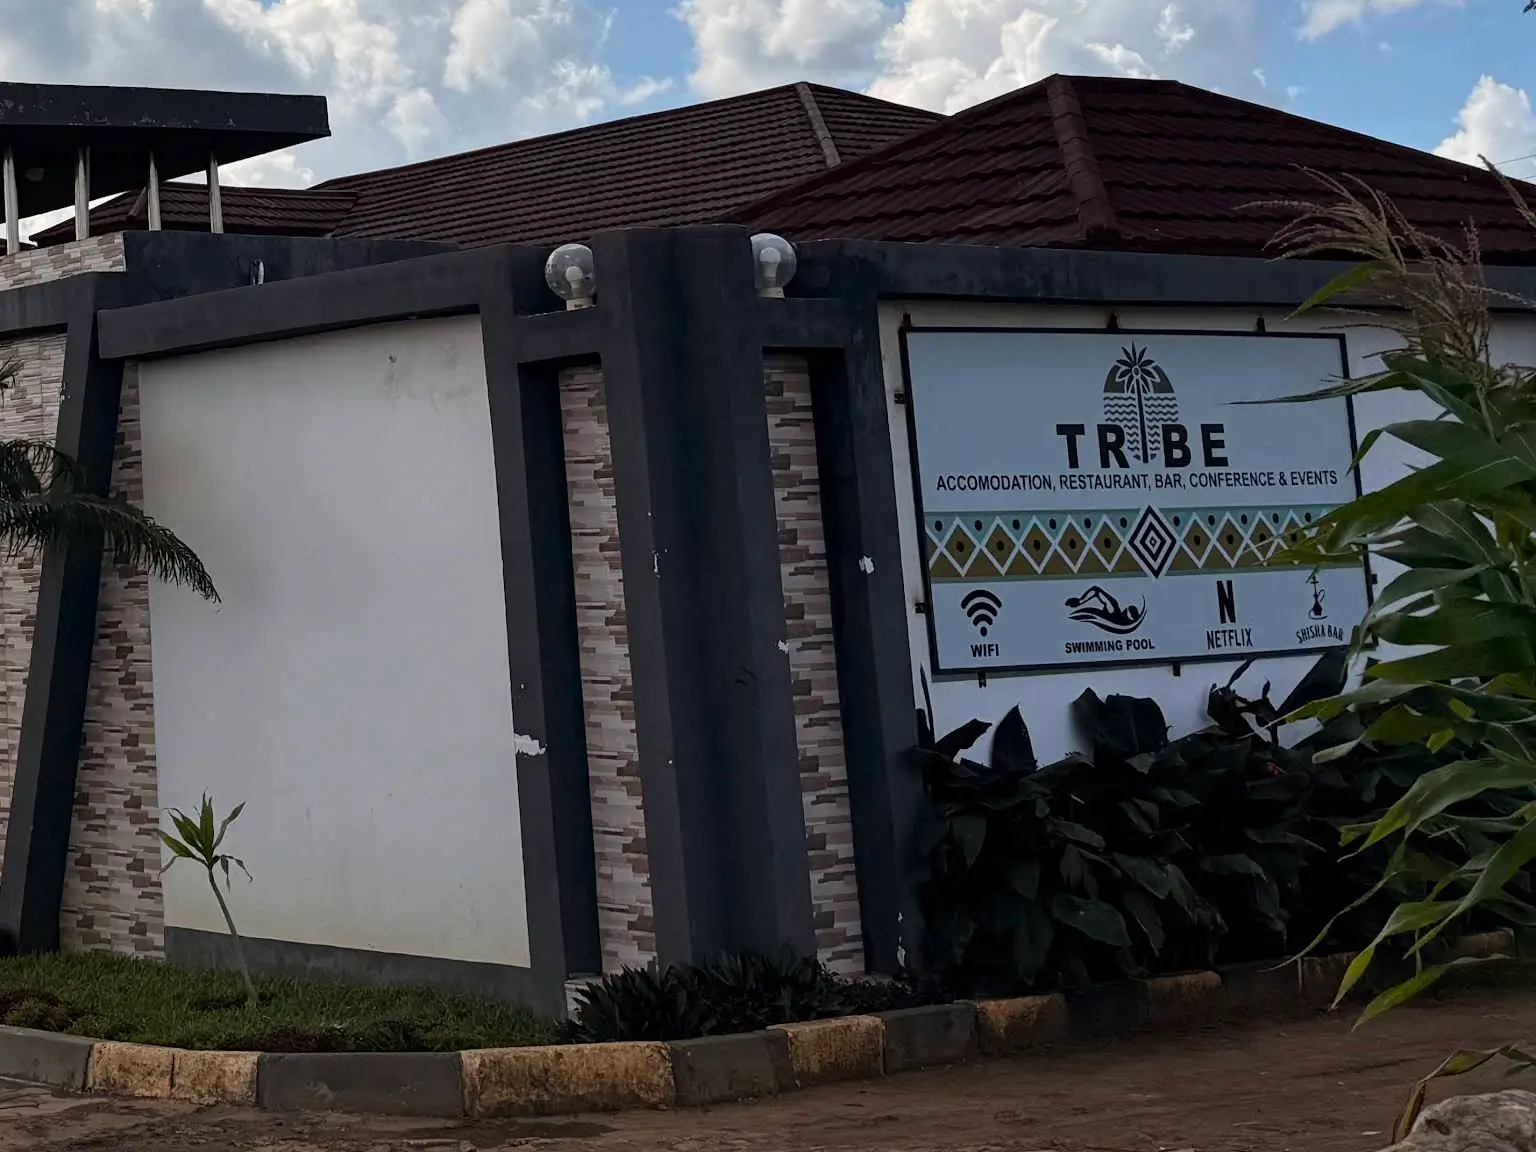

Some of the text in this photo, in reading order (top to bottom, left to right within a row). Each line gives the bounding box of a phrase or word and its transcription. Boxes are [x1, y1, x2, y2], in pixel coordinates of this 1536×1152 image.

[1055, 422, 1229, 470] TRIBE
[936, 469, 1338, 492] ACCOMODATION, RESTAURANT, BAR, CONFERENCE & EVENTS
[1206, 627, 1253, 650] NETFLIX
[1295, 624, 1344, 644] SHISHA BAR
[970, 643, 1000, 658] WIFI
[1064, 638, 1156, 654] SWIMMING POOL
